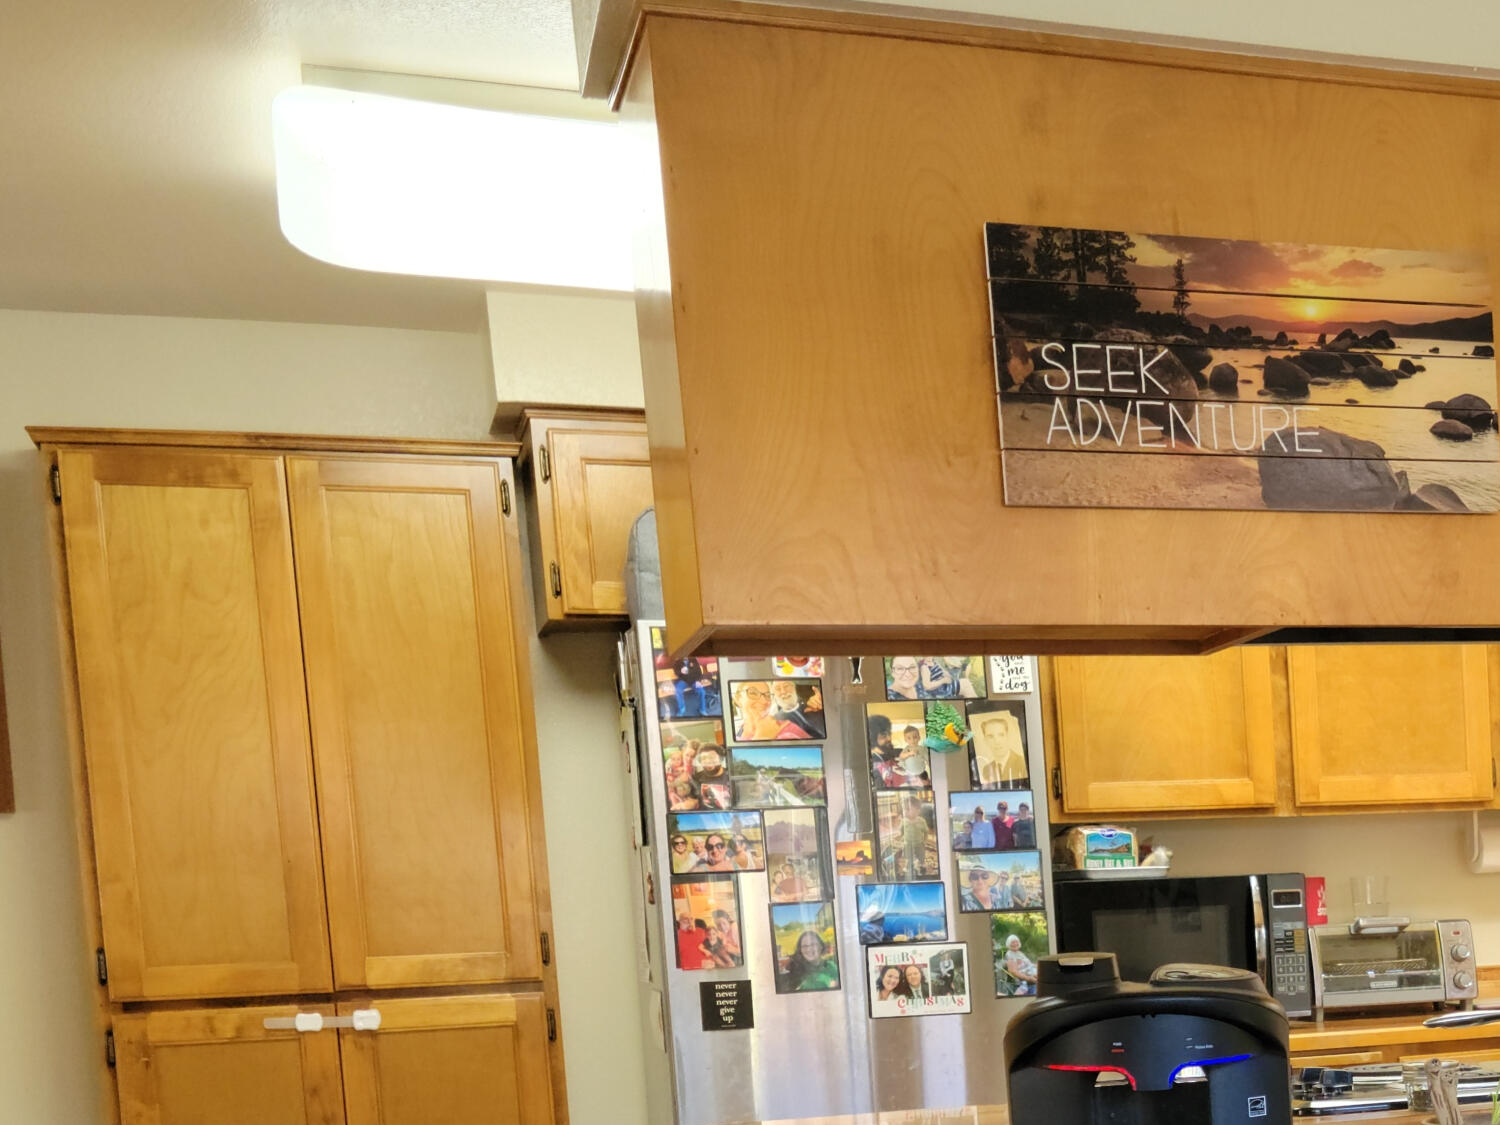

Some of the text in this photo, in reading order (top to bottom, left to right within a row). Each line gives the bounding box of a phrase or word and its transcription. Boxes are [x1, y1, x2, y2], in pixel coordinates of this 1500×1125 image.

[1041, 342, 1169, 395] SEEK
[1046, 397, 1323, 453] ADVENTURE
[1005, 678, 1028, 691] dog
[720, 1006, 735, 1016] give
[722, 1015, 734, 1023] up
